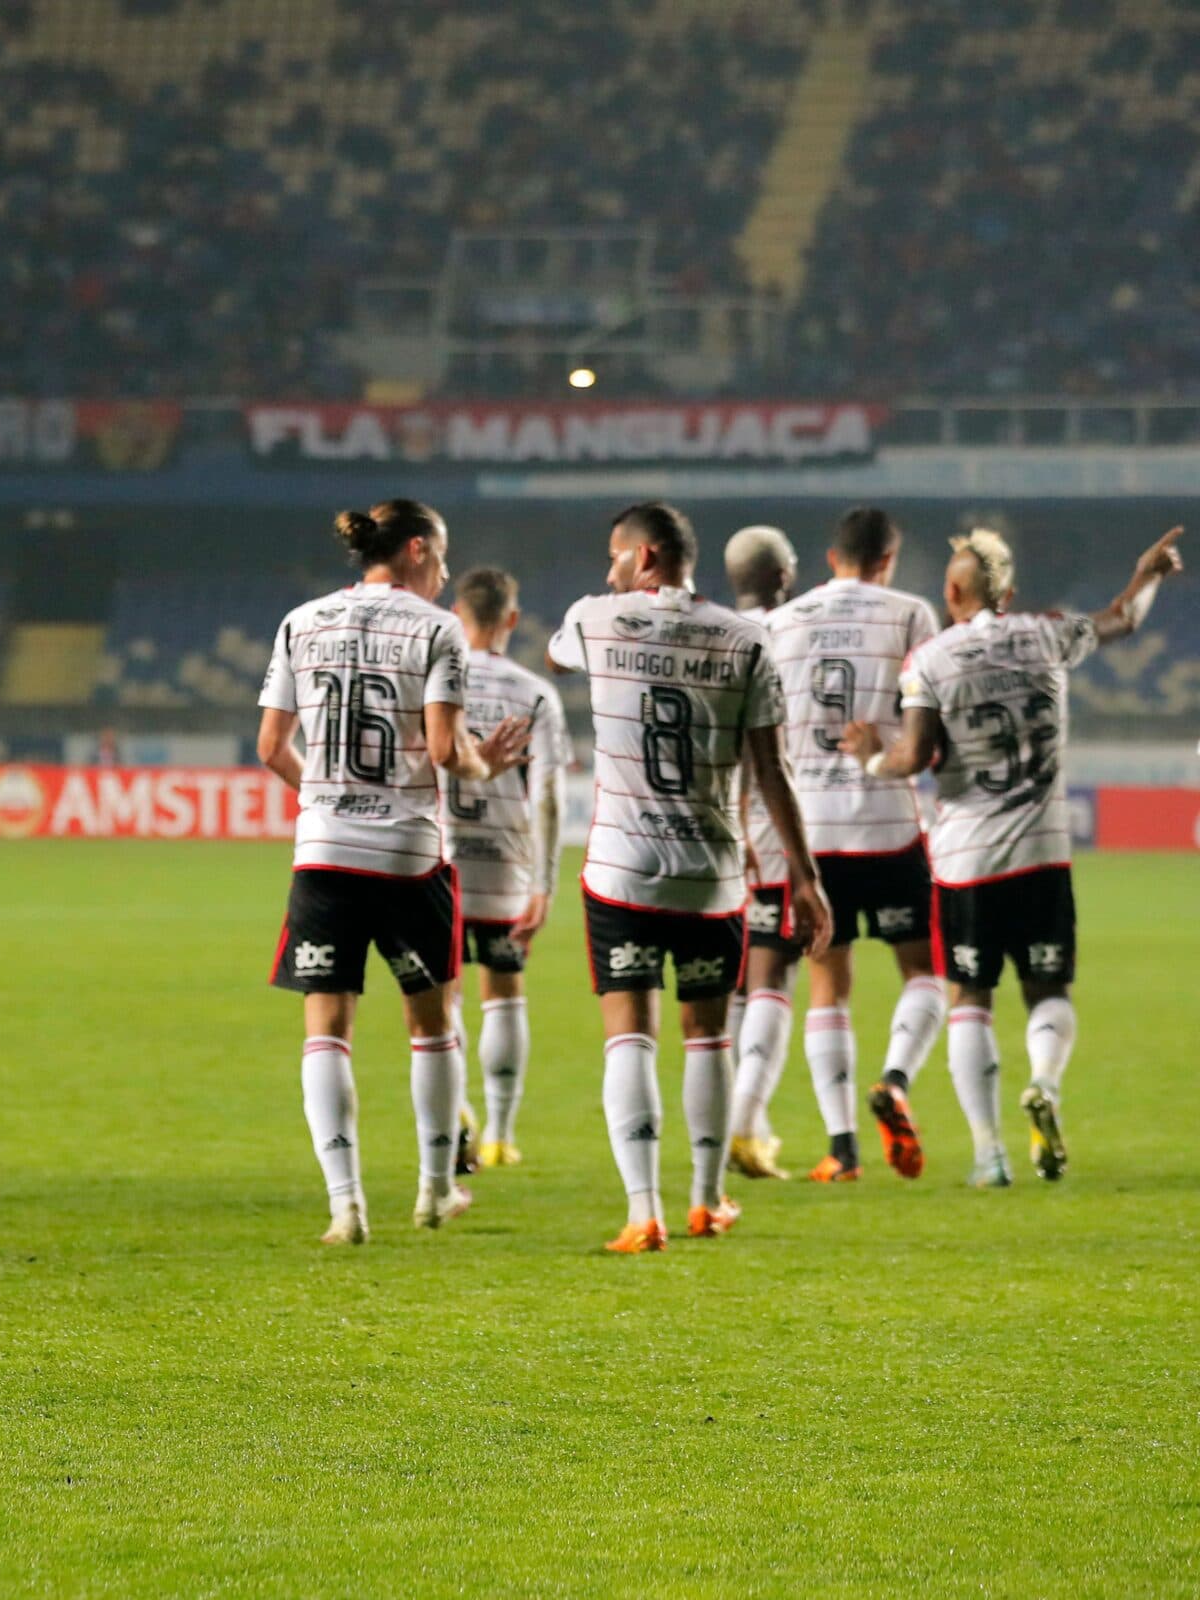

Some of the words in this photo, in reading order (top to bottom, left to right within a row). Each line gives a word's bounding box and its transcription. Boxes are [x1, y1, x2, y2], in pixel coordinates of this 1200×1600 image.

[249, 409, 388, 461] FLA
[606, 648, 675, 677] THIAGO
[683, 659, 731, 681] MAIA
[314, 671, 397, 783] 16
[811, 659, 855, 751] 9
[641, 686, 693, 795] 8
[50, 773, 296, 837] AMSTEL
[295, 941, 335, 969] abc
[609, 941, 657, 970] abc
[677, 957, 724, 979] abc
